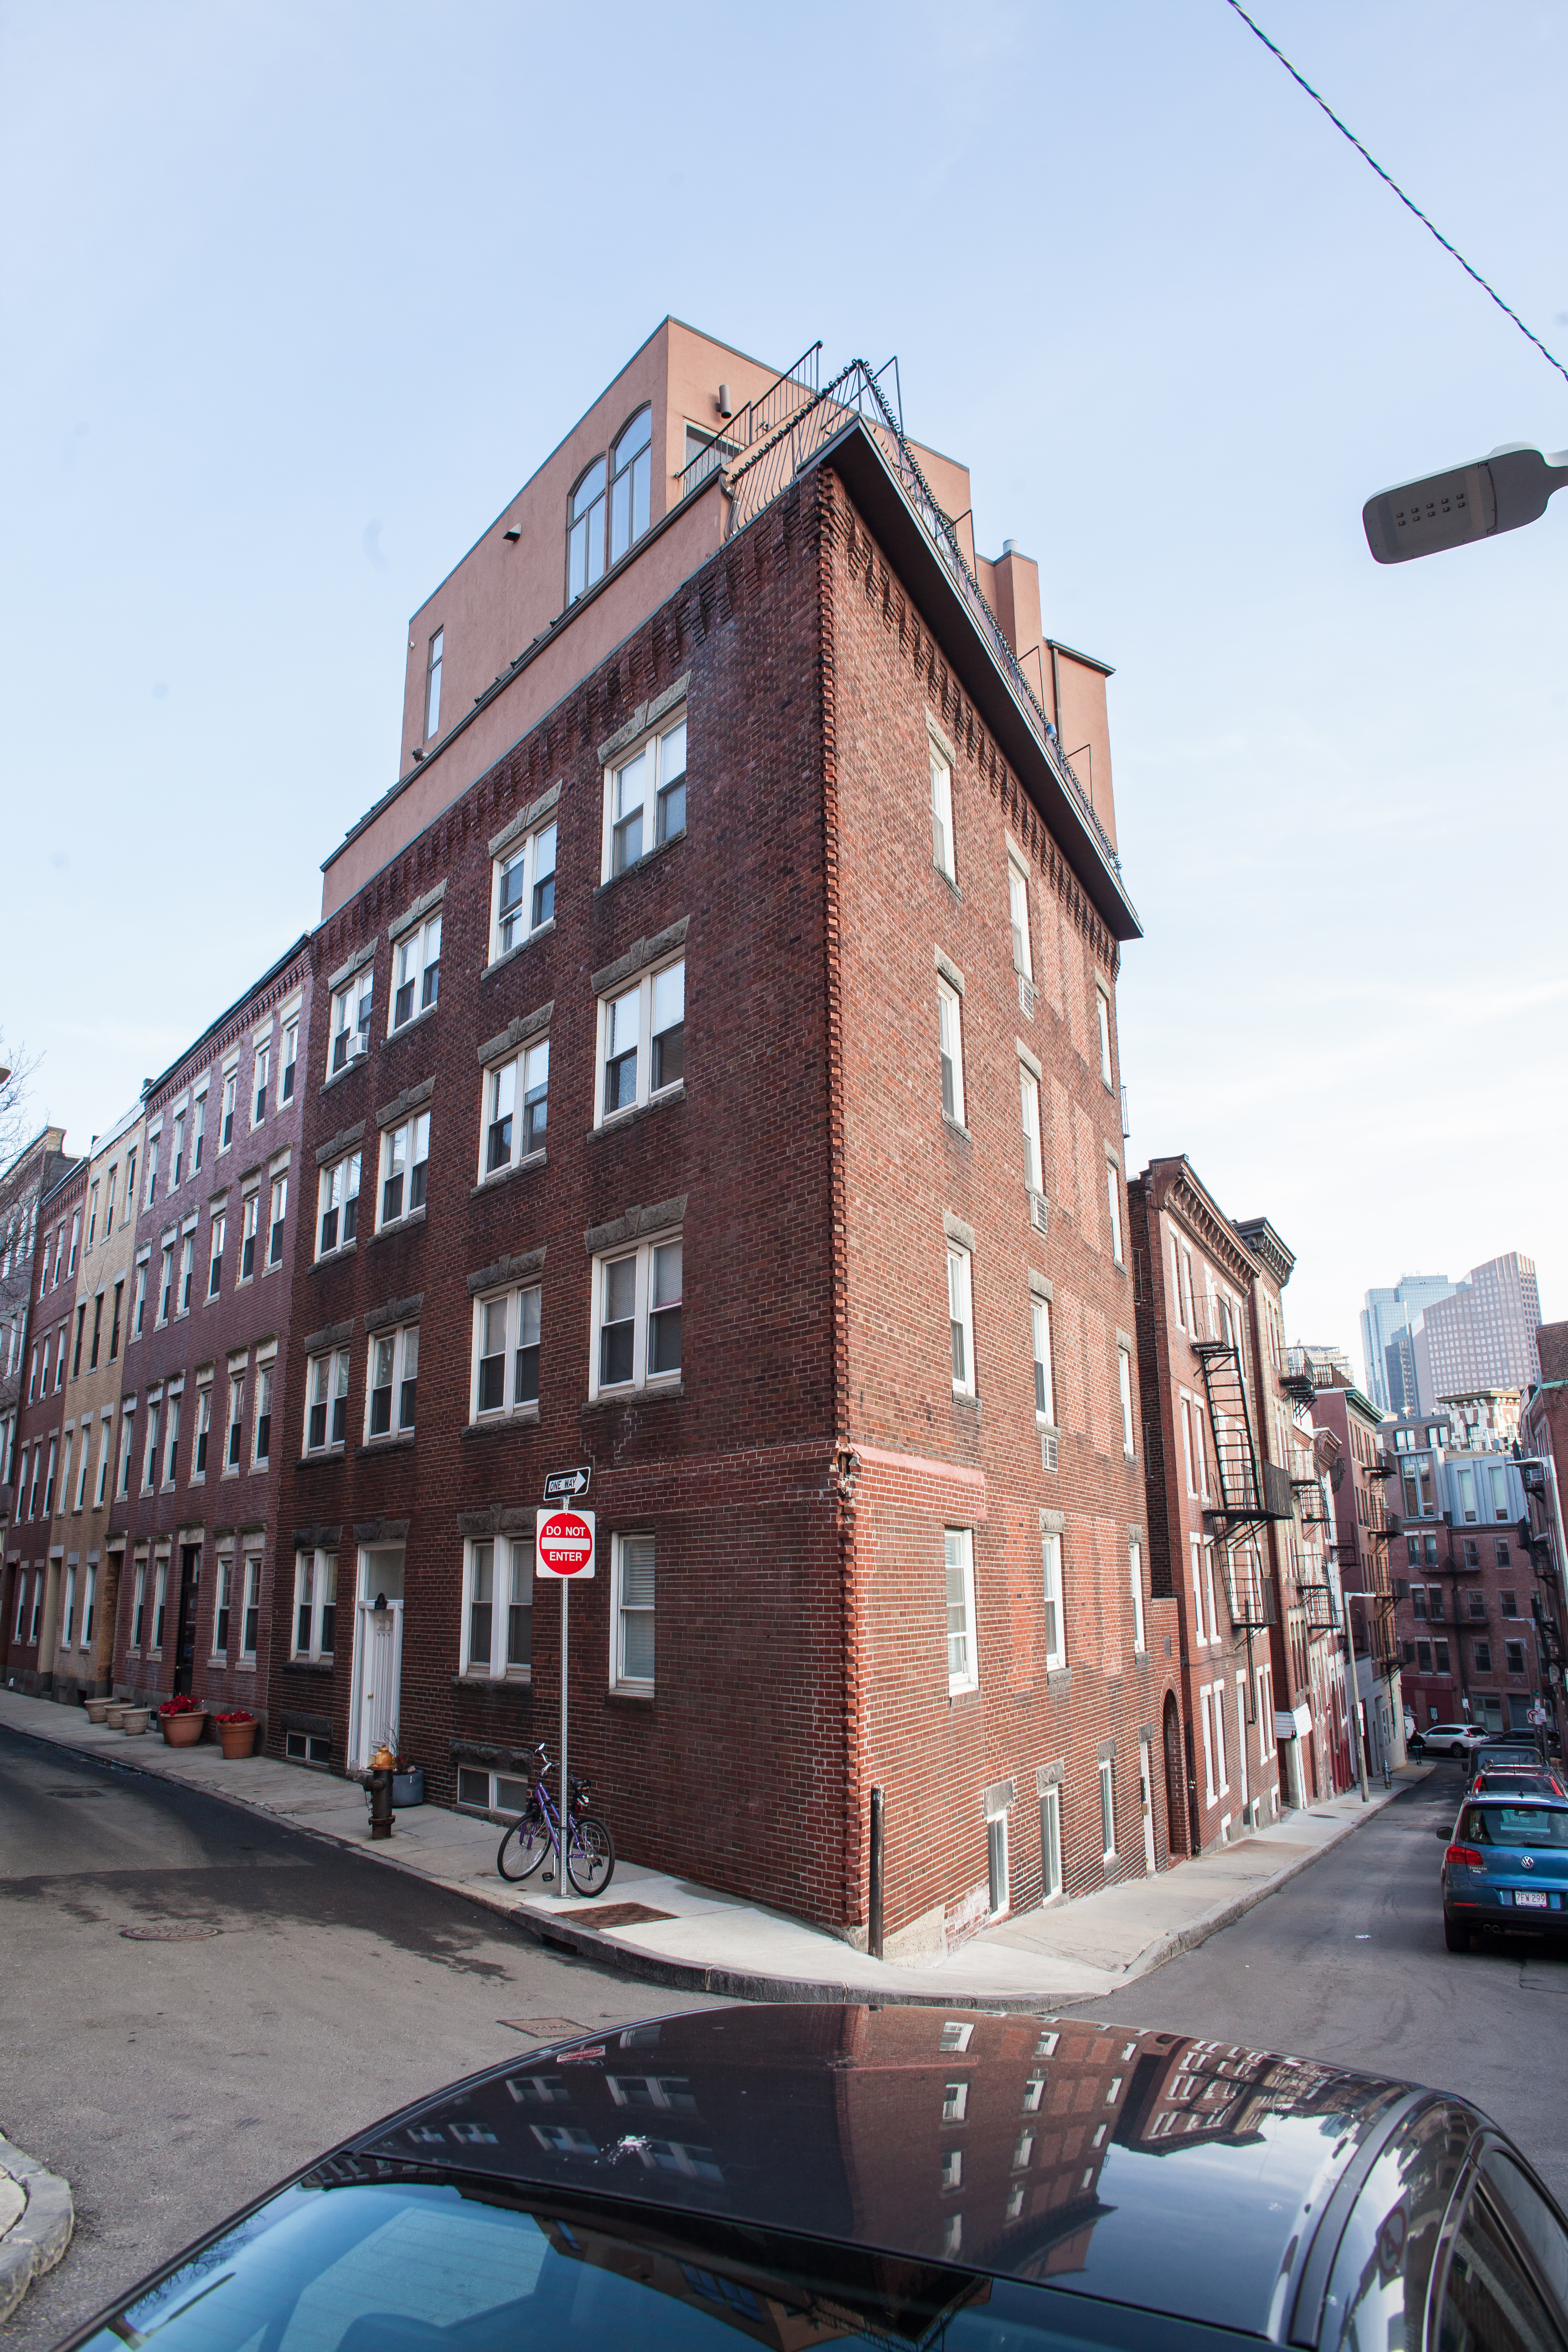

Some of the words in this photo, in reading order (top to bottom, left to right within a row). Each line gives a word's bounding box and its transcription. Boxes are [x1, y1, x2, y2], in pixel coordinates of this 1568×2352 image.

[550, 1480, 562, 1491] ONE
[565, 1478, 577, 1488] WAY
[546, 1526, 561, 1536] DO
[565, 1527, 585, 1536] NOT
[549, 1551, 582, 1561] ENTER
[1516, 1893, 1529, 1902] 7FW
[1532, 1894, 1545, 1903] 299
